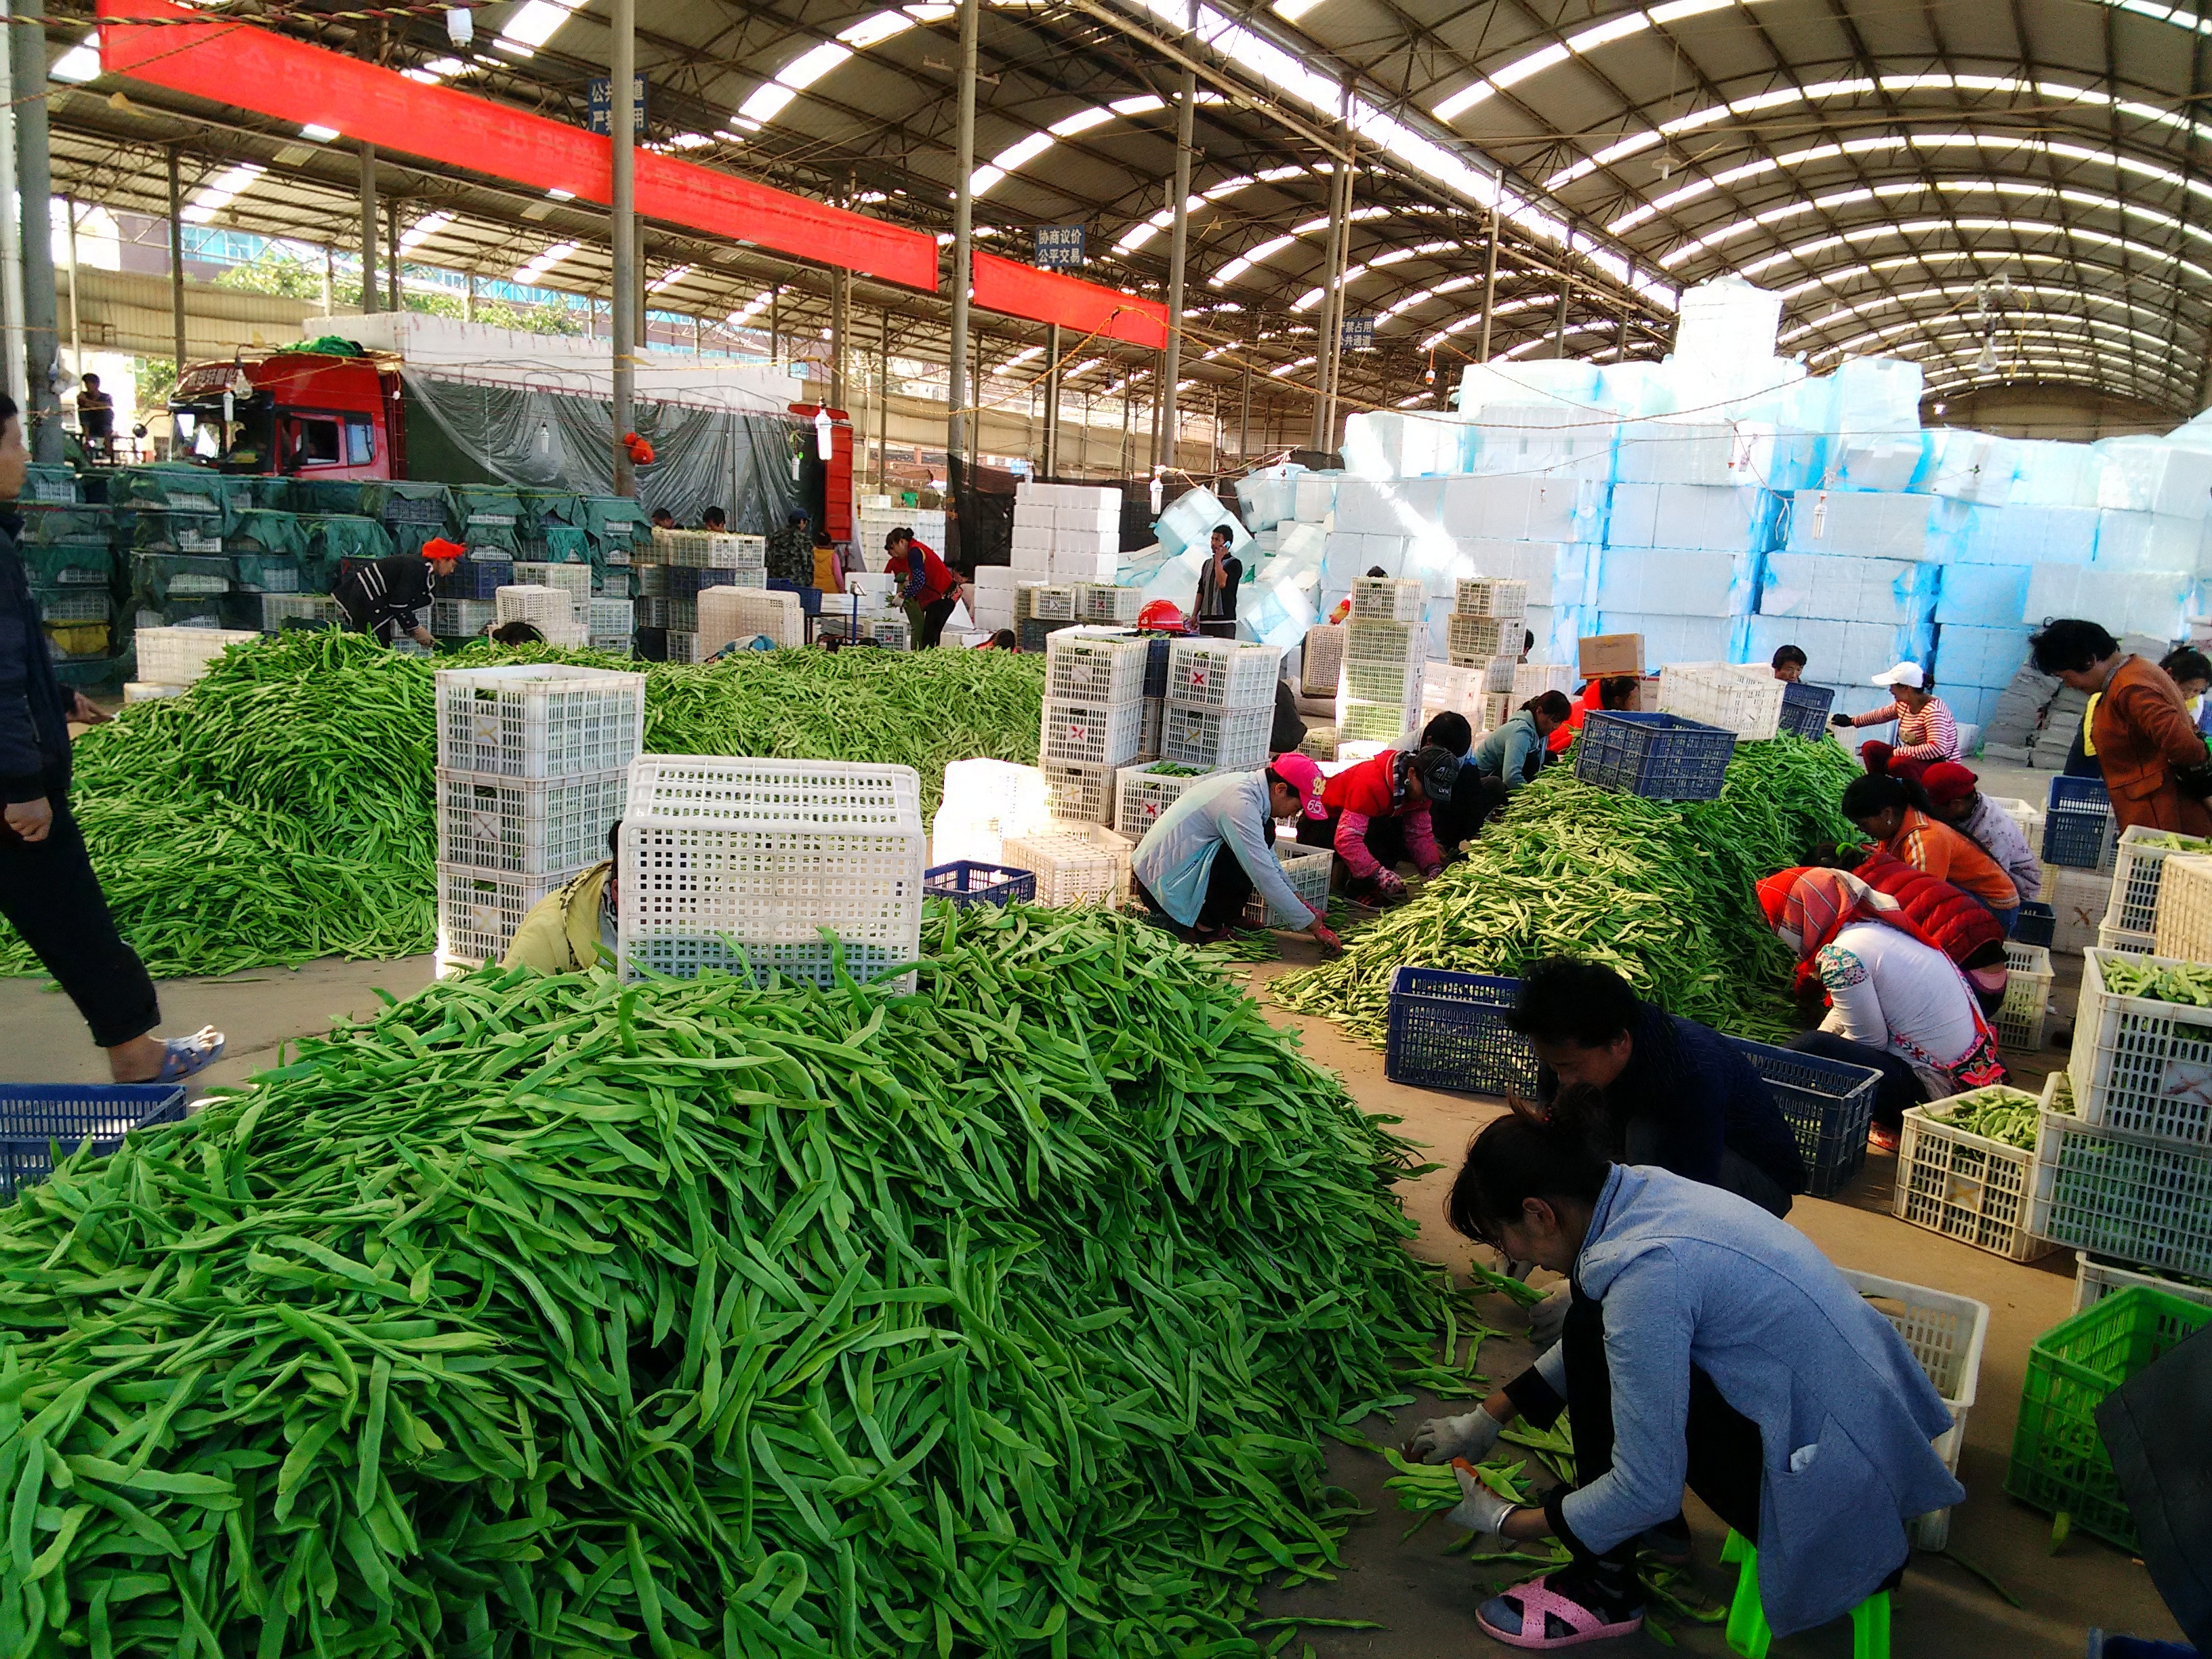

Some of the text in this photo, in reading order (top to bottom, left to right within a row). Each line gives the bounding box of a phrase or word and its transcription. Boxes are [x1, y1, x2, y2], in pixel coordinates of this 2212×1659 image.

[592, 79, 644, 102] 公共道
[592, 108, 644, 131] 严禁用
[1038, 228, 1082, 245] 协商议价
[1038, 247, 1080, 263] 公平交易
[1307, 800, 1322, 814] 65
